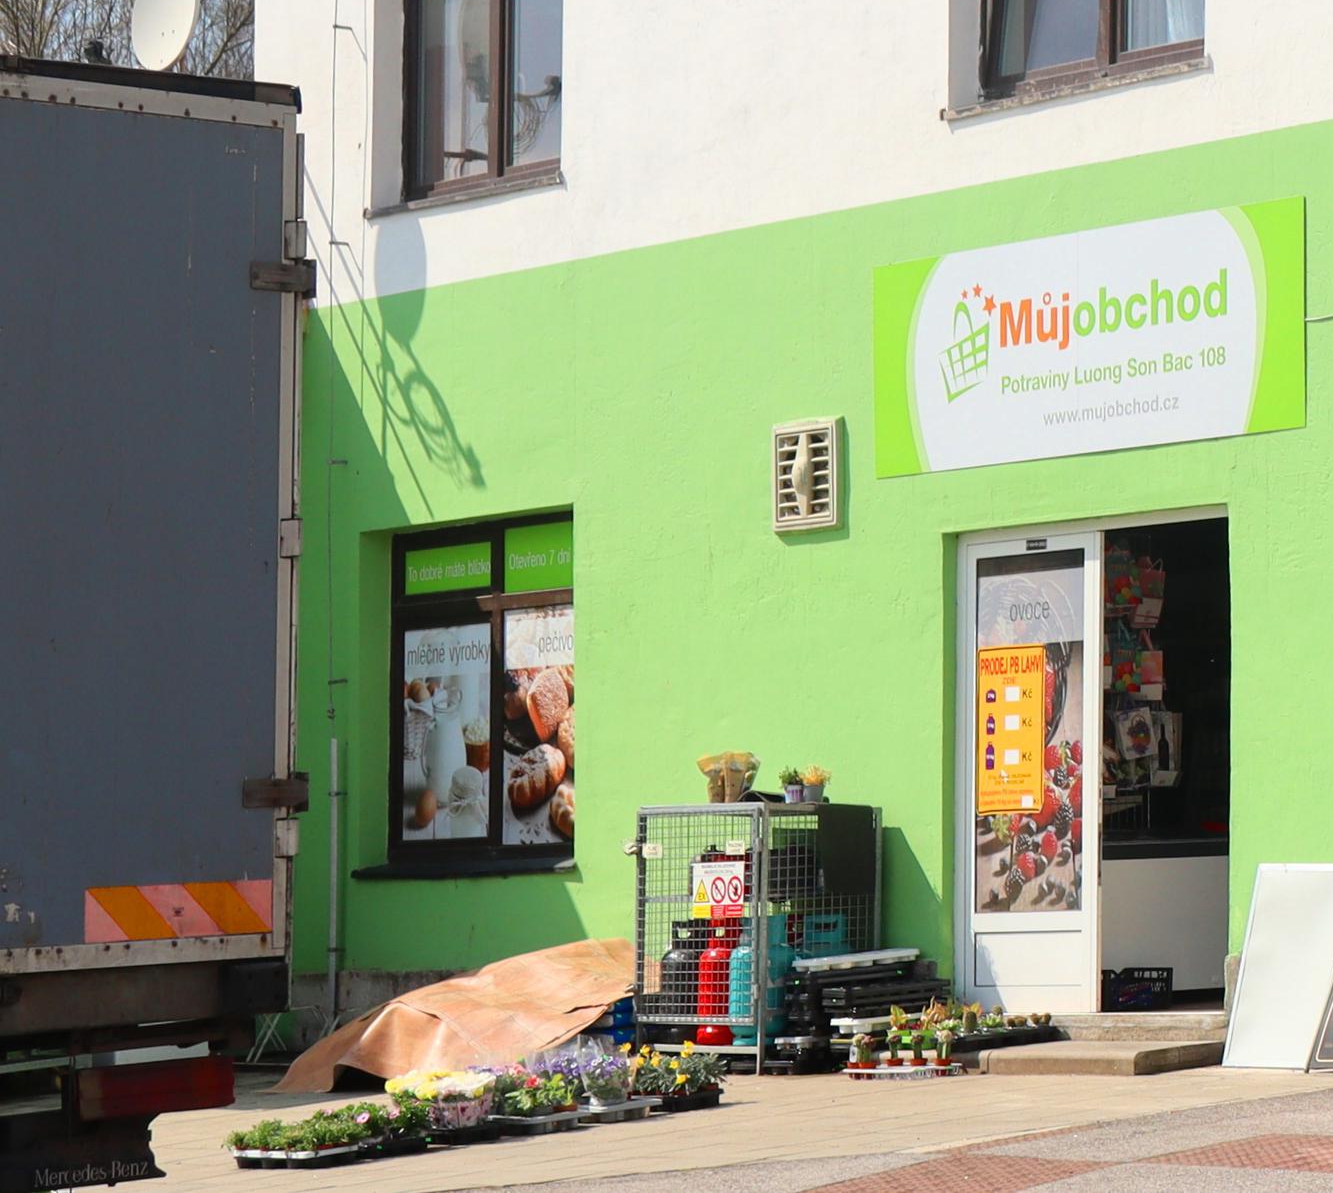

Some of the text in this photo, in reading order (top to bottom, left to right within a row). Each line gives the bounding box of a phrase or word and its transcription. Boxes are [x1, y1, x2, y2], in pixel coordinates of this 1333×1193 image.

[1000, 268, 1228, 350] Můjobchod
[1001, 346, 1226, 394] Potraviny Luong Son Bac 108
[1043, 394, 1180, 426] www.mujobchod.cz
[549, 550, 555, 566] 7
[408, 566, 418, 582] To
[419, 563, 443, 581] dobré
[445, 562, 466, 578] máte
[1009, 599, 1050, 622] ovoce
[407, 639, 490, 666] mléčné výrobky
[538, 631, 573, 658] pečivo
[980, 656, 1008, 676] PRODEJ
[1010, 655, 1019, 675] PB
[1022, 688, 1033, 699] Kč
[1022, 717, 1033, 727] Kč
[1022, 752, 1033, 762] Kč
[34, 1159, 149, 1188] Mercedes-Benz
